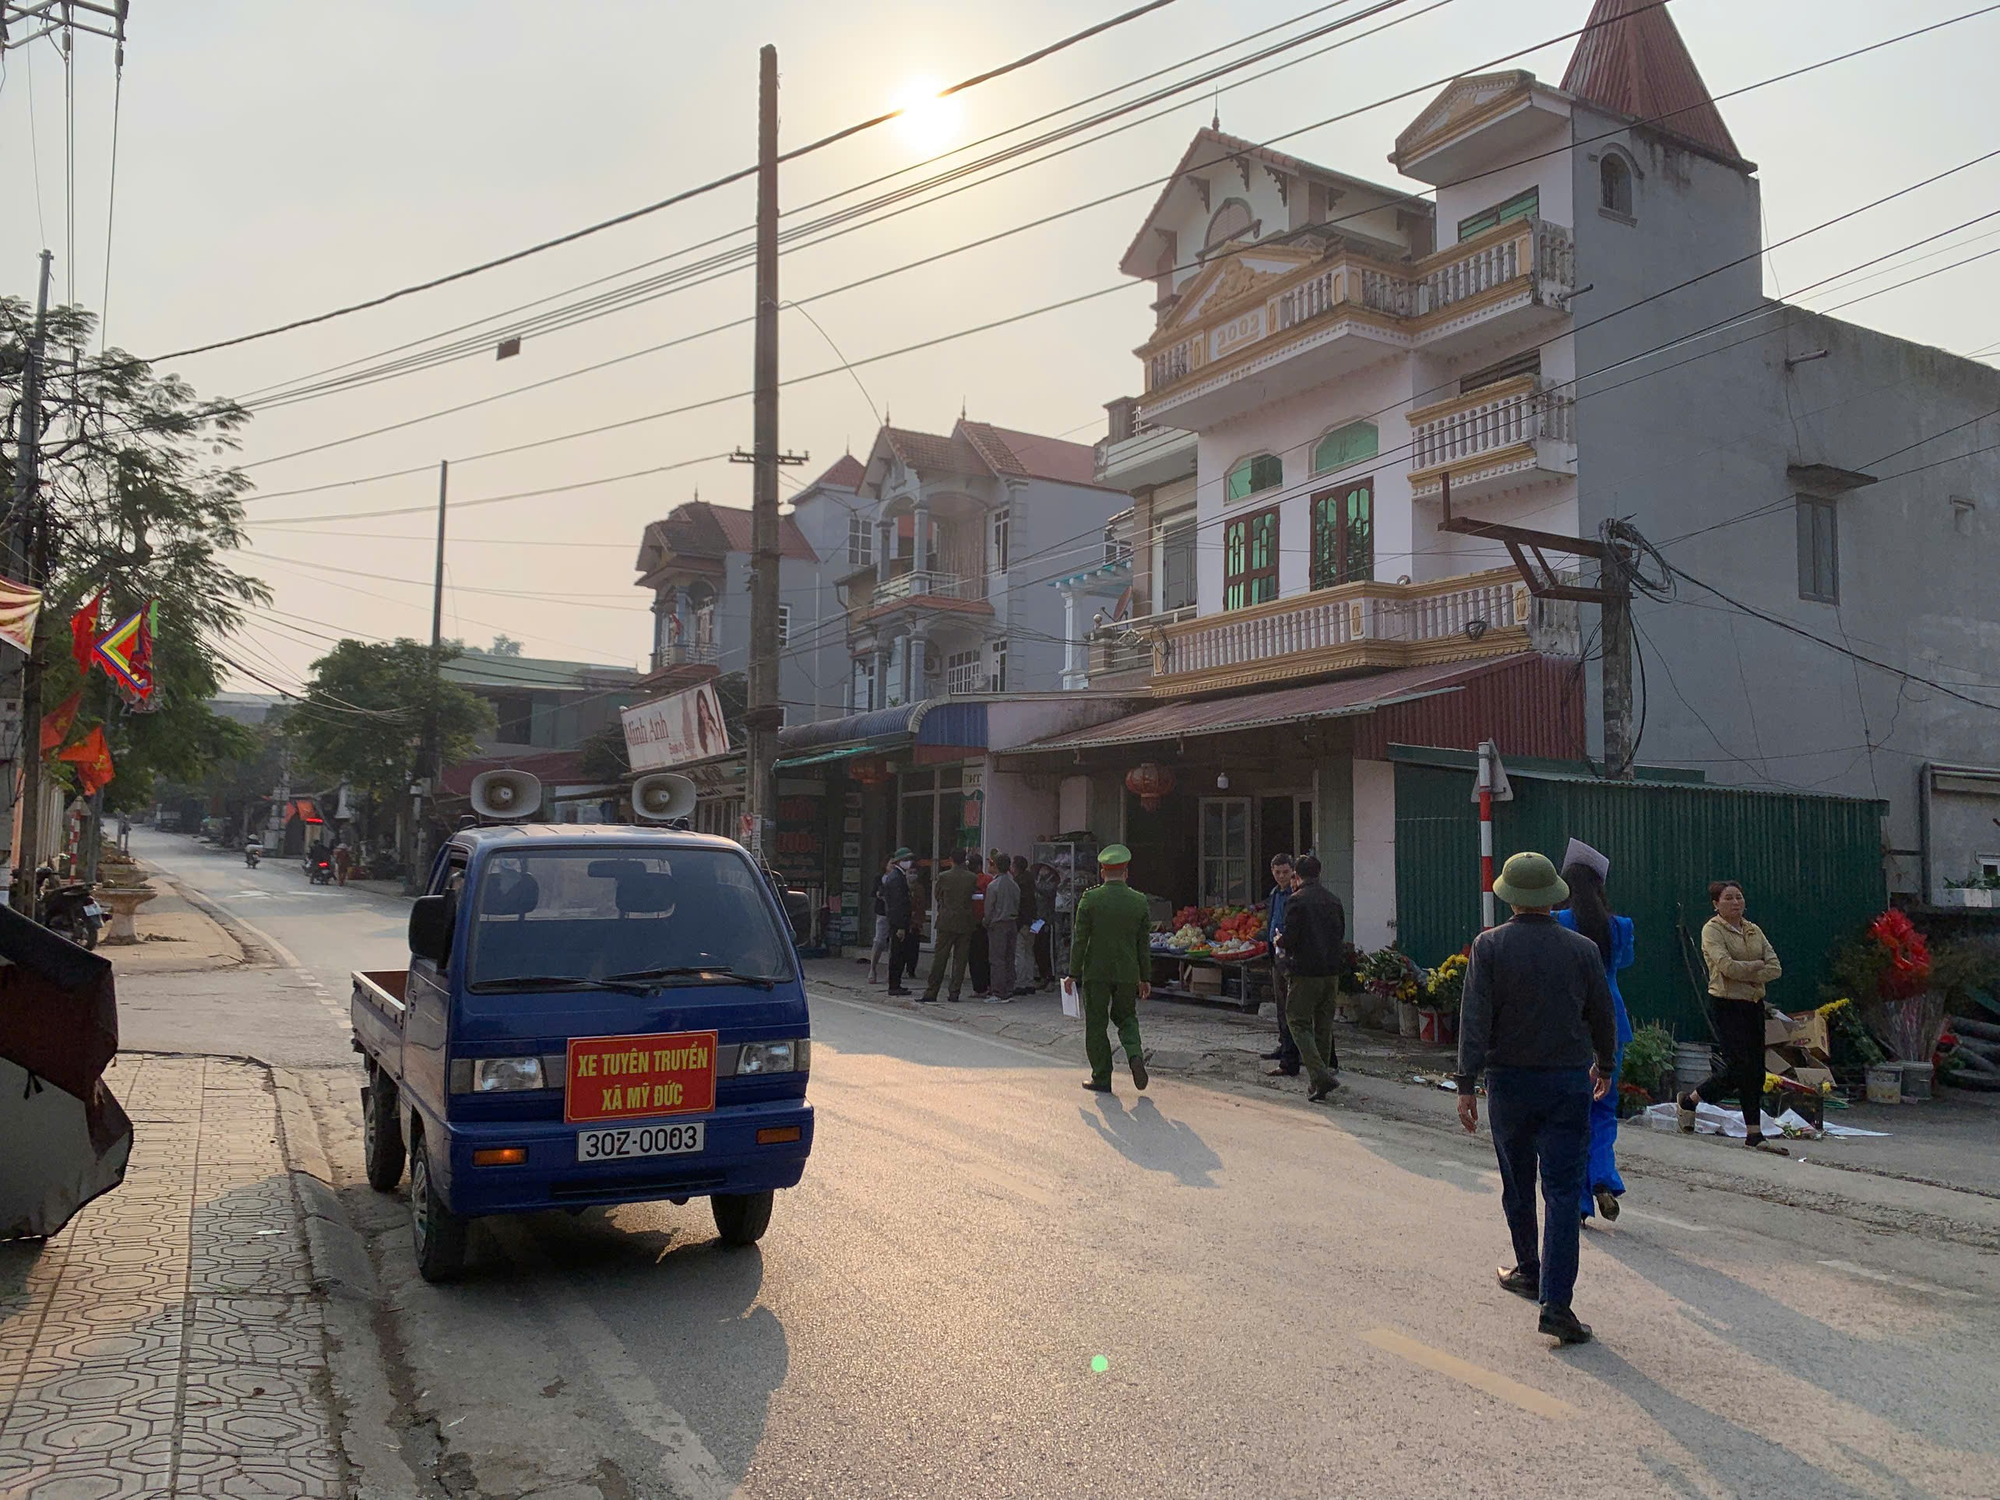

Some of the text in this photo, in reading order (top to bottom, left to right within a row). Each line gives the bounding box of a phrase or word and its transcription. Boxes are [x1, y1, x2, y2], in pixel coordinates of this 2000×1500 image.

[1217, 314, 1260, 349] 2002
[623, 711, 670, 746] Minh Anh
[577, 1054, 598, 1077] XE
[602, 1047, 649, 1075] TUYÊN
[601, 1079, 684, 1111] XÃ MỸ ĐỨC
[585, 1125, 698, 1158] 30Z-0003
